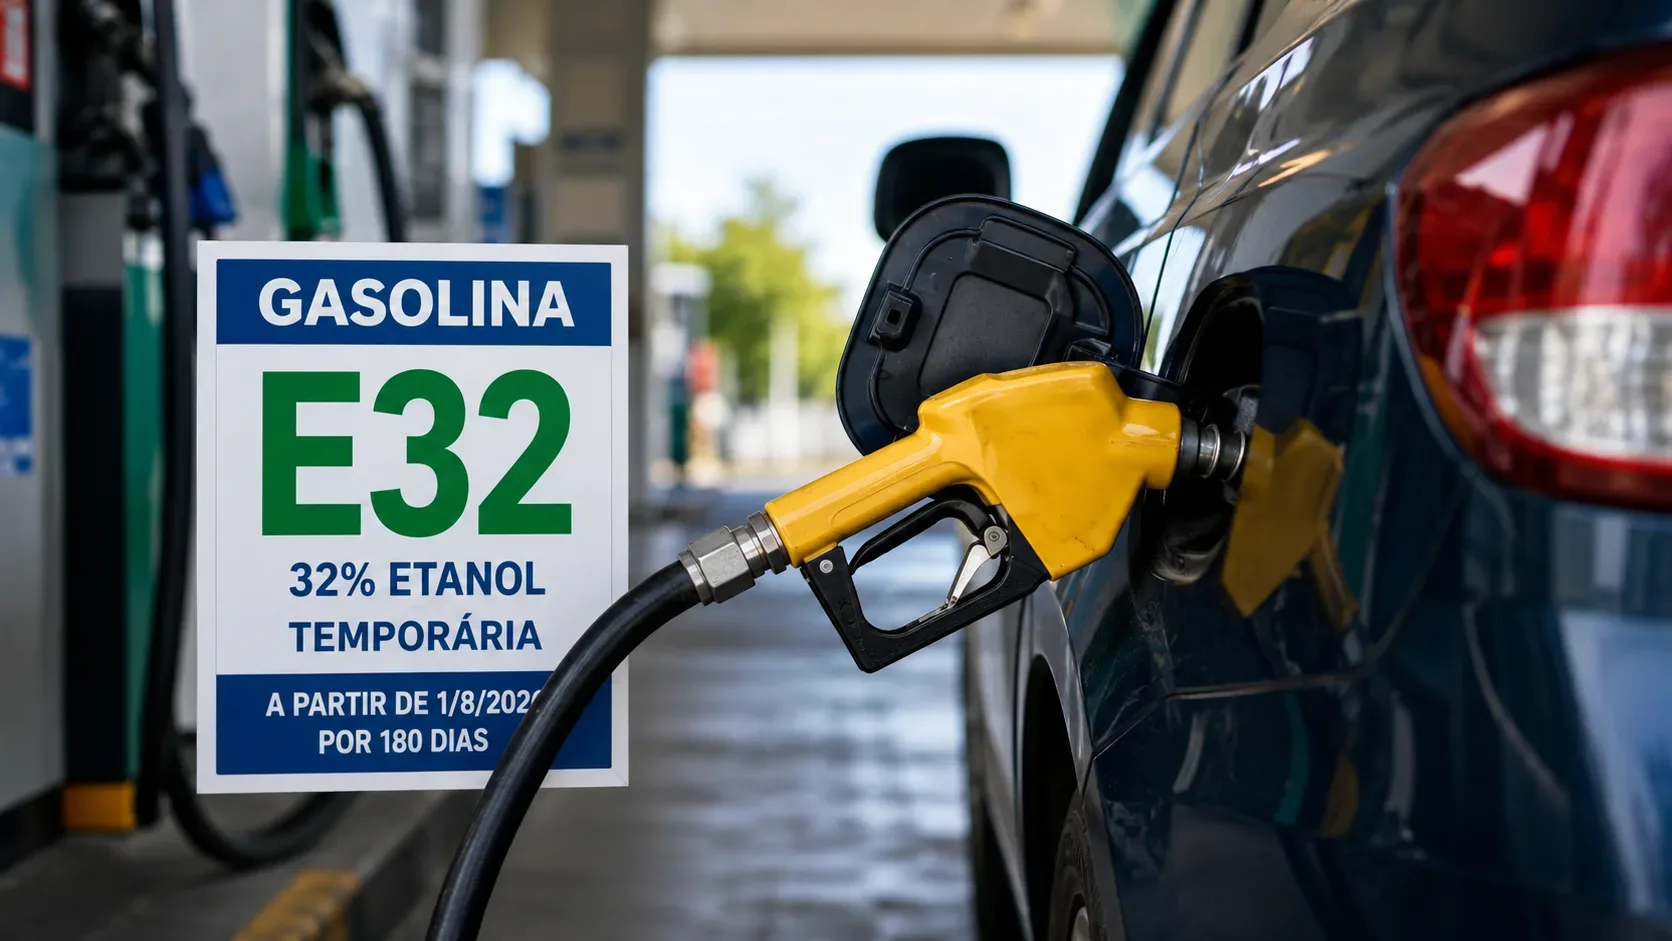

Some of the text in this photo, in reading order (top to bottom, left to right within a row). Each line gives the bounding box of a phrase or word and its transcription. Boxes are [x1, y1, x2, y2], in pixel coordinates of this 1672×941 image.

[258, 277, 575, 327] GASOLINA
[261, 368, 573, 538] E32
[289, 560, 546, 598] 32% ETANOL
[288, 612, 543, 653] TEMPORÁRIA
[265, 689, 542, 717] A PARTIR DE 1/8/202
[319, 727, 489, 755] POR 180 DIAS
